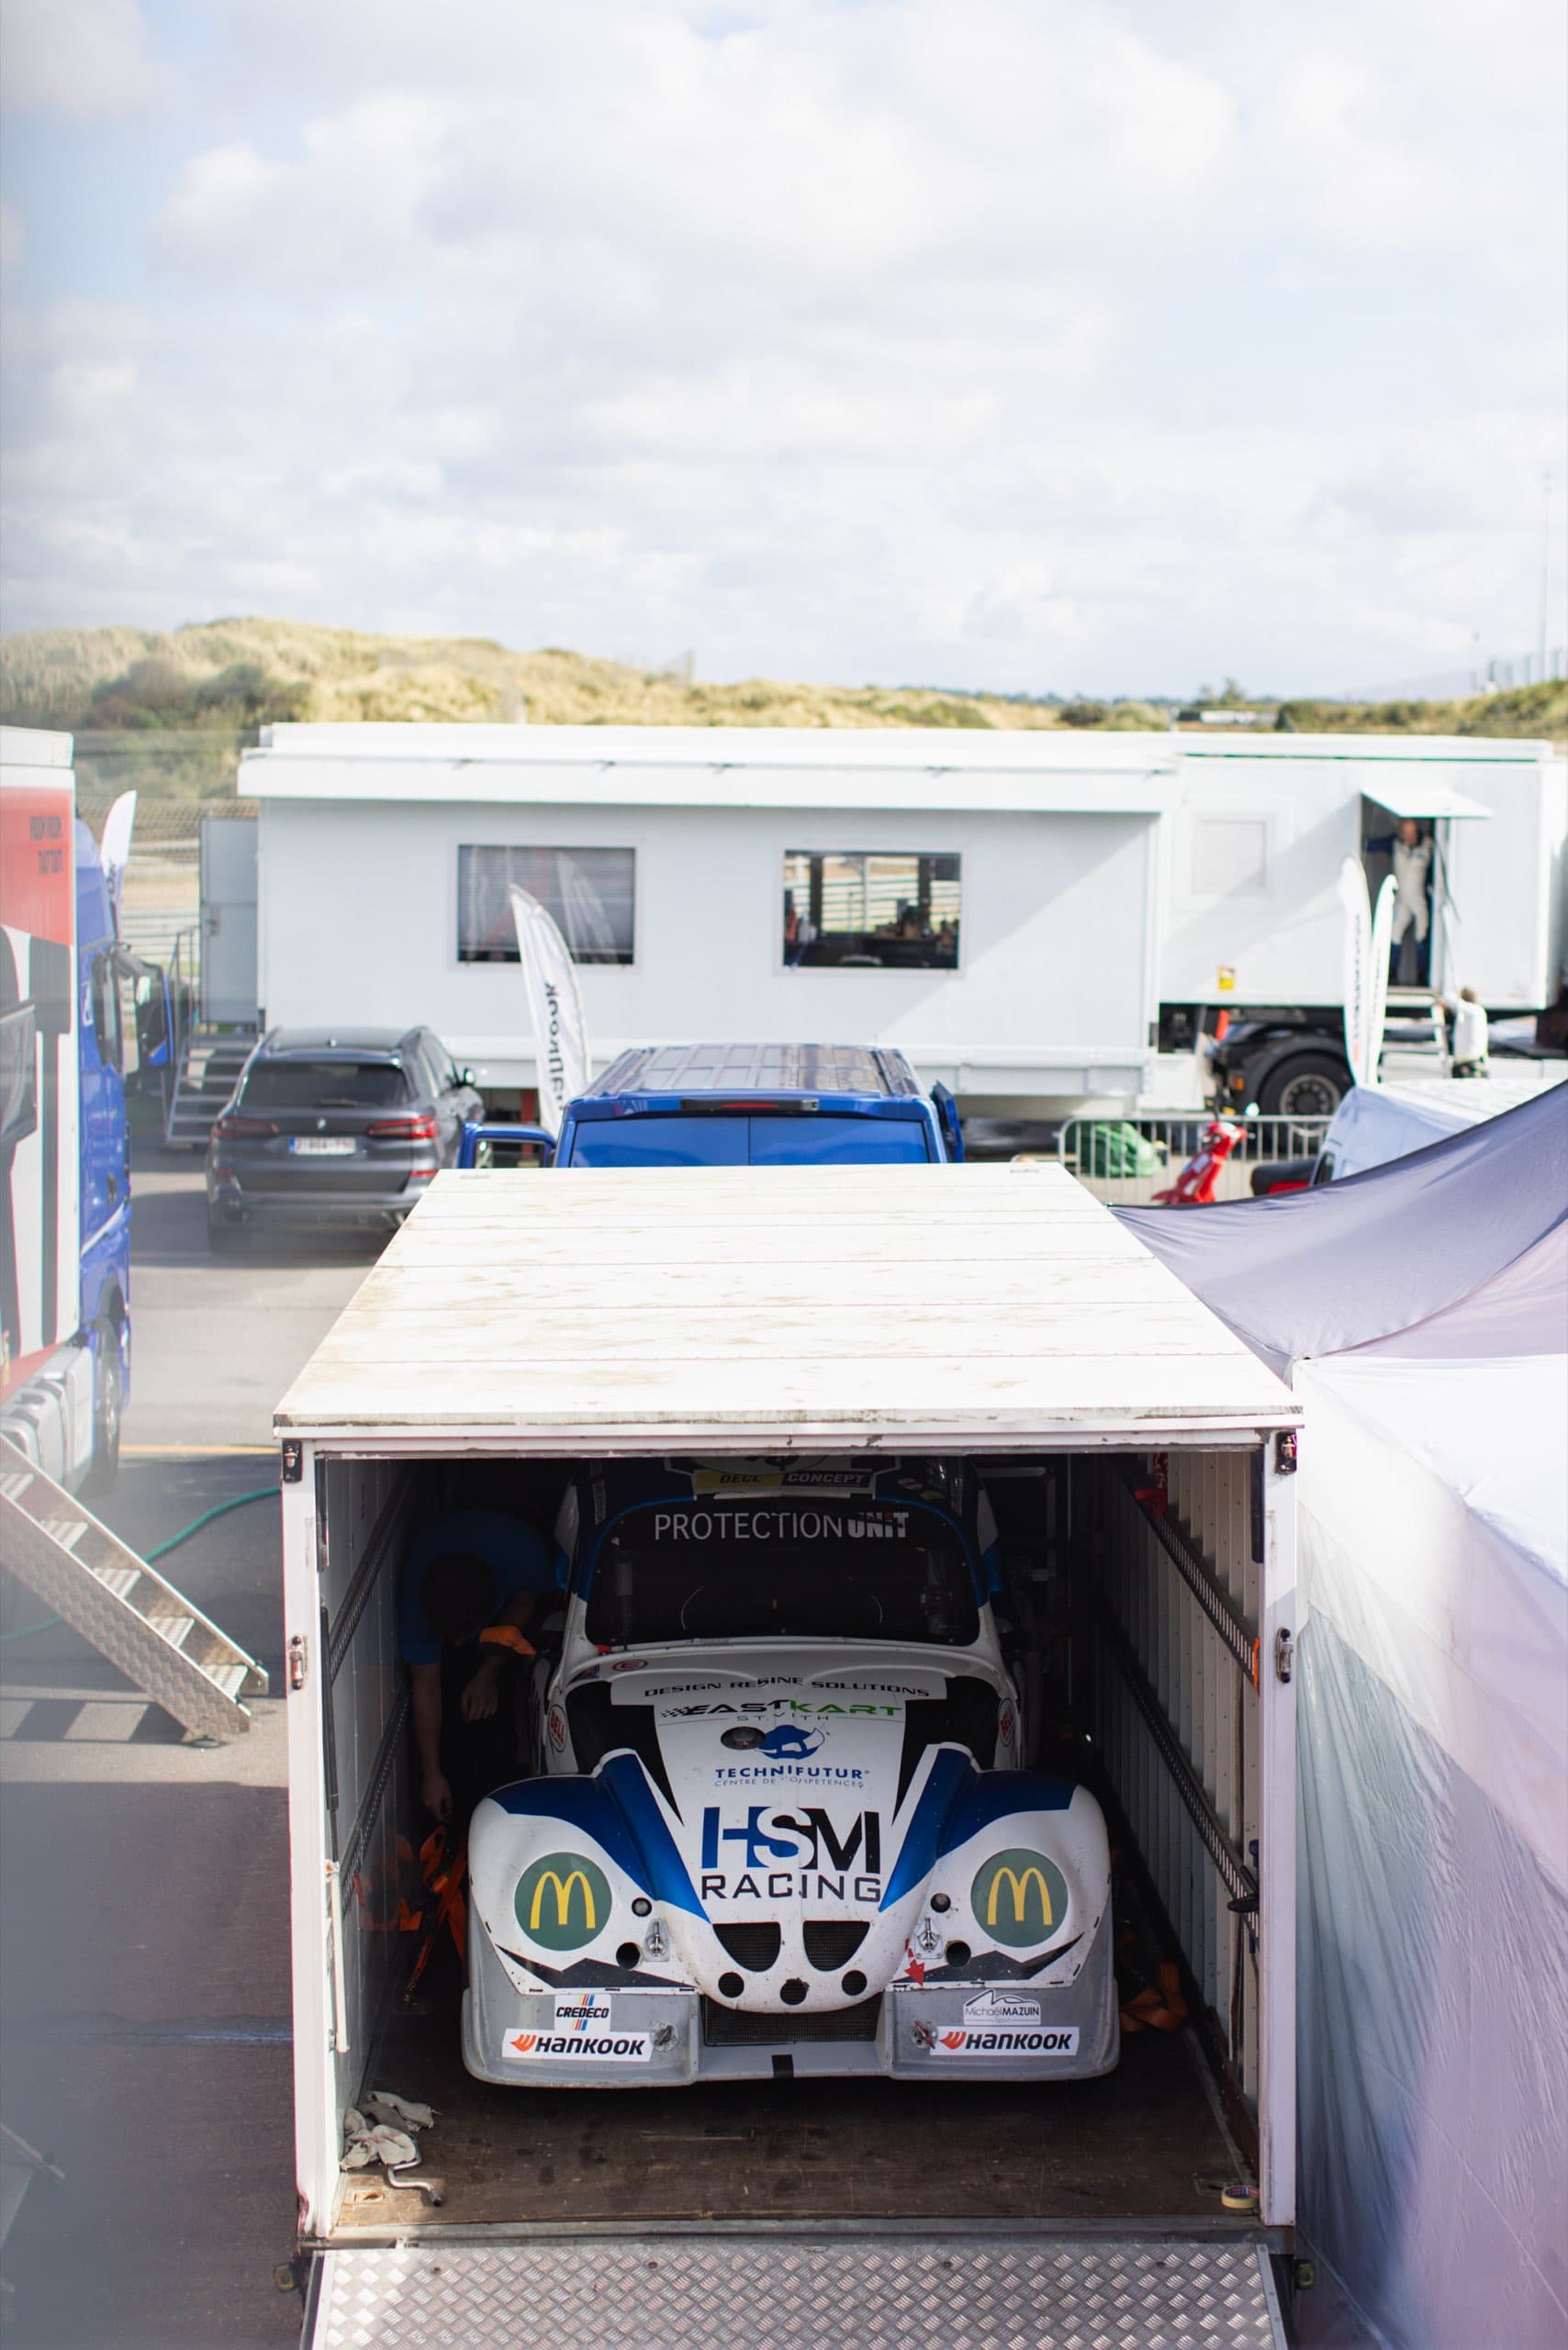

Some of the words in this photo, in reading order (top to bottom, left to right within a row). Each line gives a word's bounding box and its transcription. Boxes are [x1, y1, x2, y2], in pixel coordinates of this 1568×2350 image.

[788, 1472, 864, 1484] CONCEPT
[655, 1512, 843, 1540] PROTECTION
[847, 1512, 909, 1539] UNIT
[644, 1683, 722, 1697] DESIGN
[730, 1676, 804, 1688] RESINE
[812, 1681, 930, 1696] SOLUTIONS
[714, 1778, 757, 1787] CENTRE
[763, 1777, 776, 1785] DE
[701, 1806, 881, 1874] HSM
[701, 1873, 881, 1903] RACING
[556, 2007, 610, 2019] CREDECO
